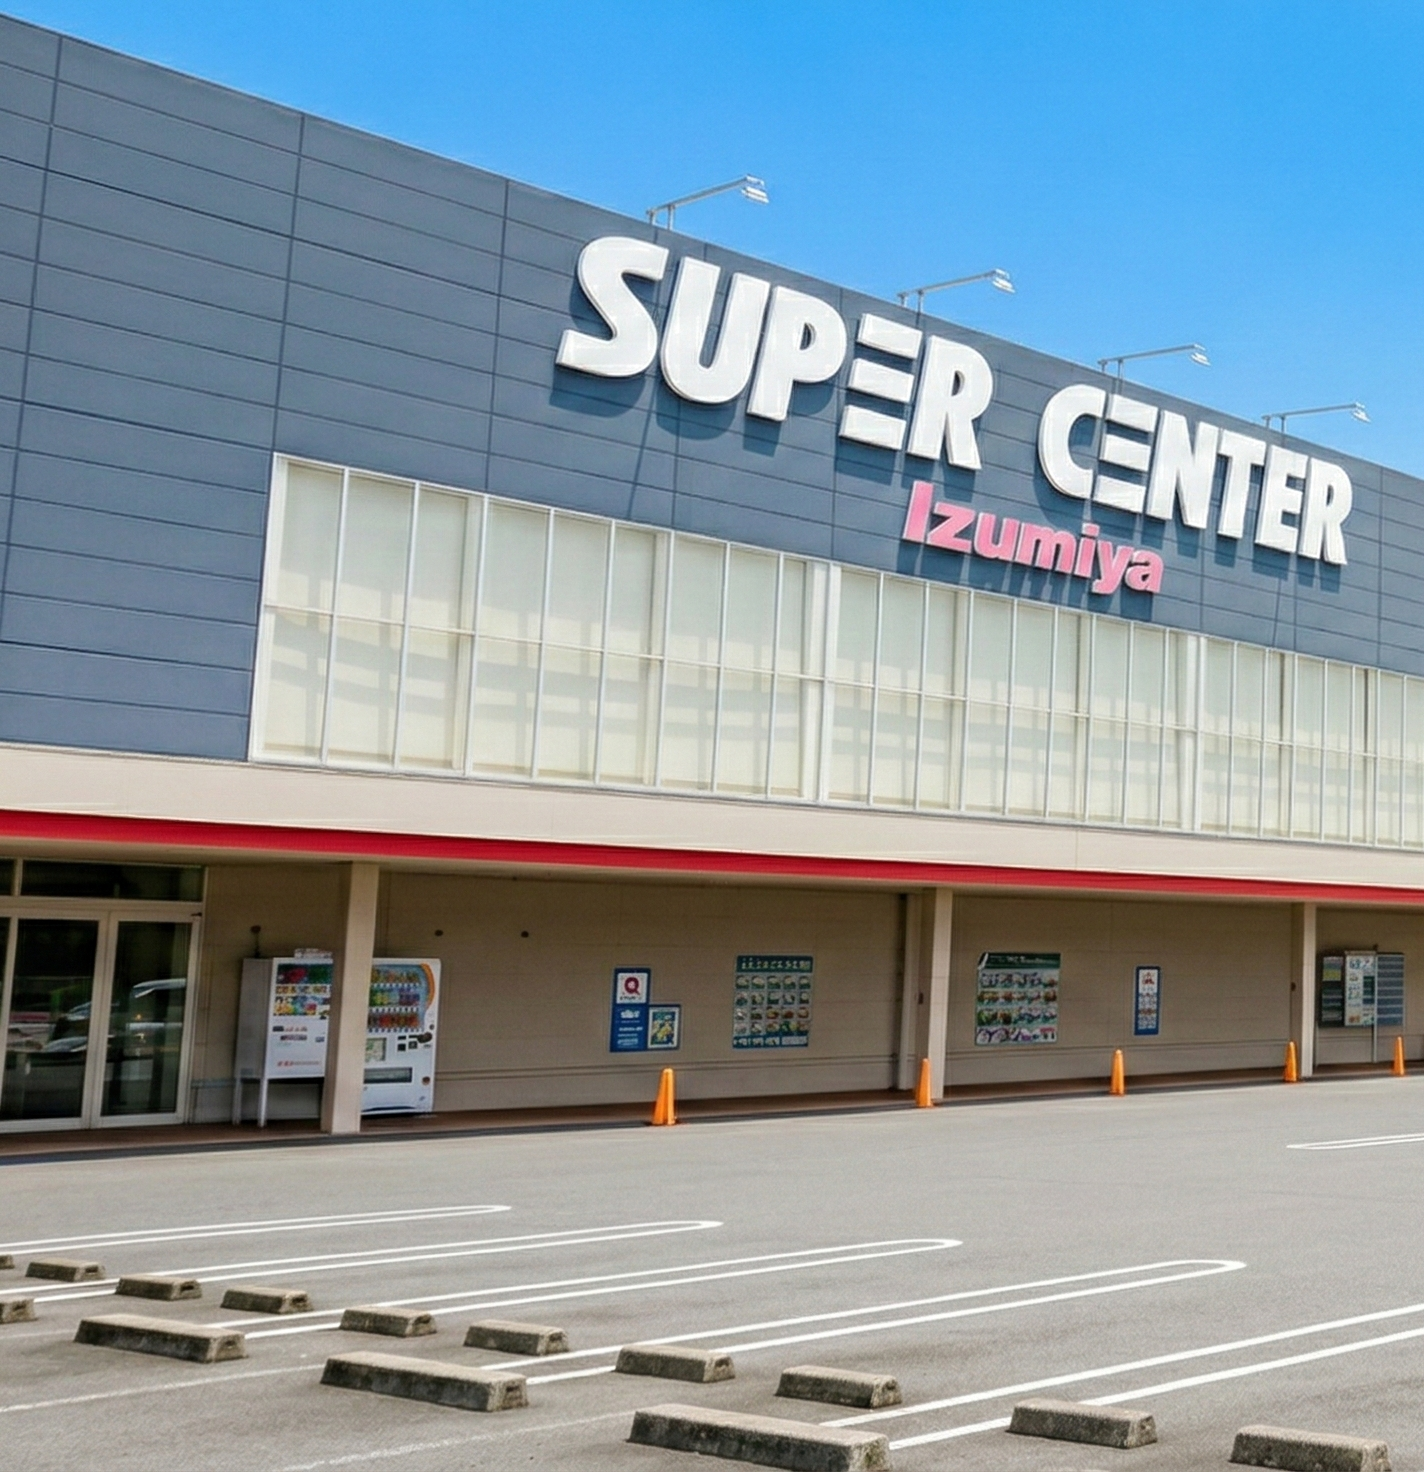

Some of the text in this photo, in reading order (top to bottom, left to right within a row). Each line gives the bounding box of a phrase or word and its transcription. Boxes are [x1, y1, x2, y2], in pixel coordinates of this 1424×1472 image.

[555, 236, 1354, 565] SUPER CENTER
[902, 480, 1165, 594] Izumiya
